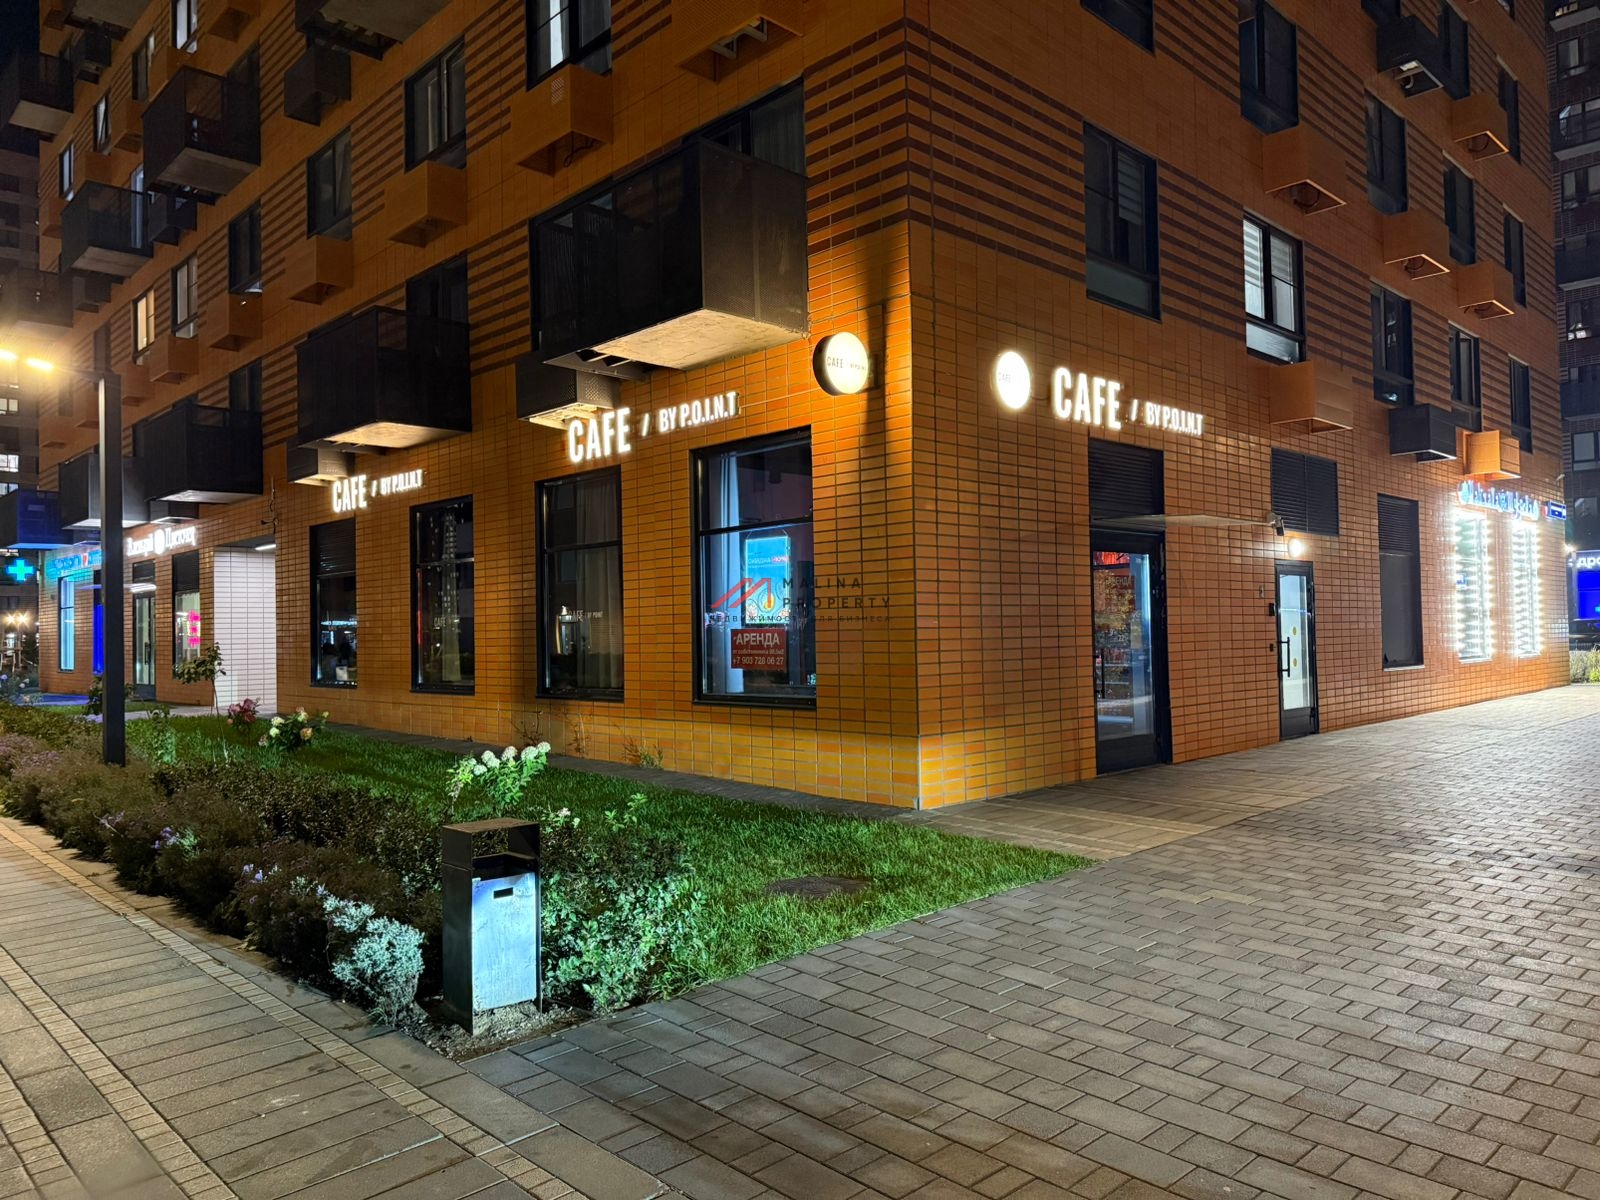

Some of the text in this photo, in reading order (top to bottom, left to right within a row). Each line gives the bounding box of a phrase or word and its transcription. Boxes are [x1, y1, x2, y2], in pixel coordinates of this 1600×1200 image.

[1053, 366, 1122, 430] CAFE
[1145, 401, 1161, 426] BY
[568, 407, 632, 464] CAFE
[658, 406, 677, 433] BY
[680, 391, 737, 428] P.O.I.N.T
[332, 474, 368, 513] CAFE
[380, 476, 392, 496] BY
[736, 633, 780, 648] АРЕНДА
